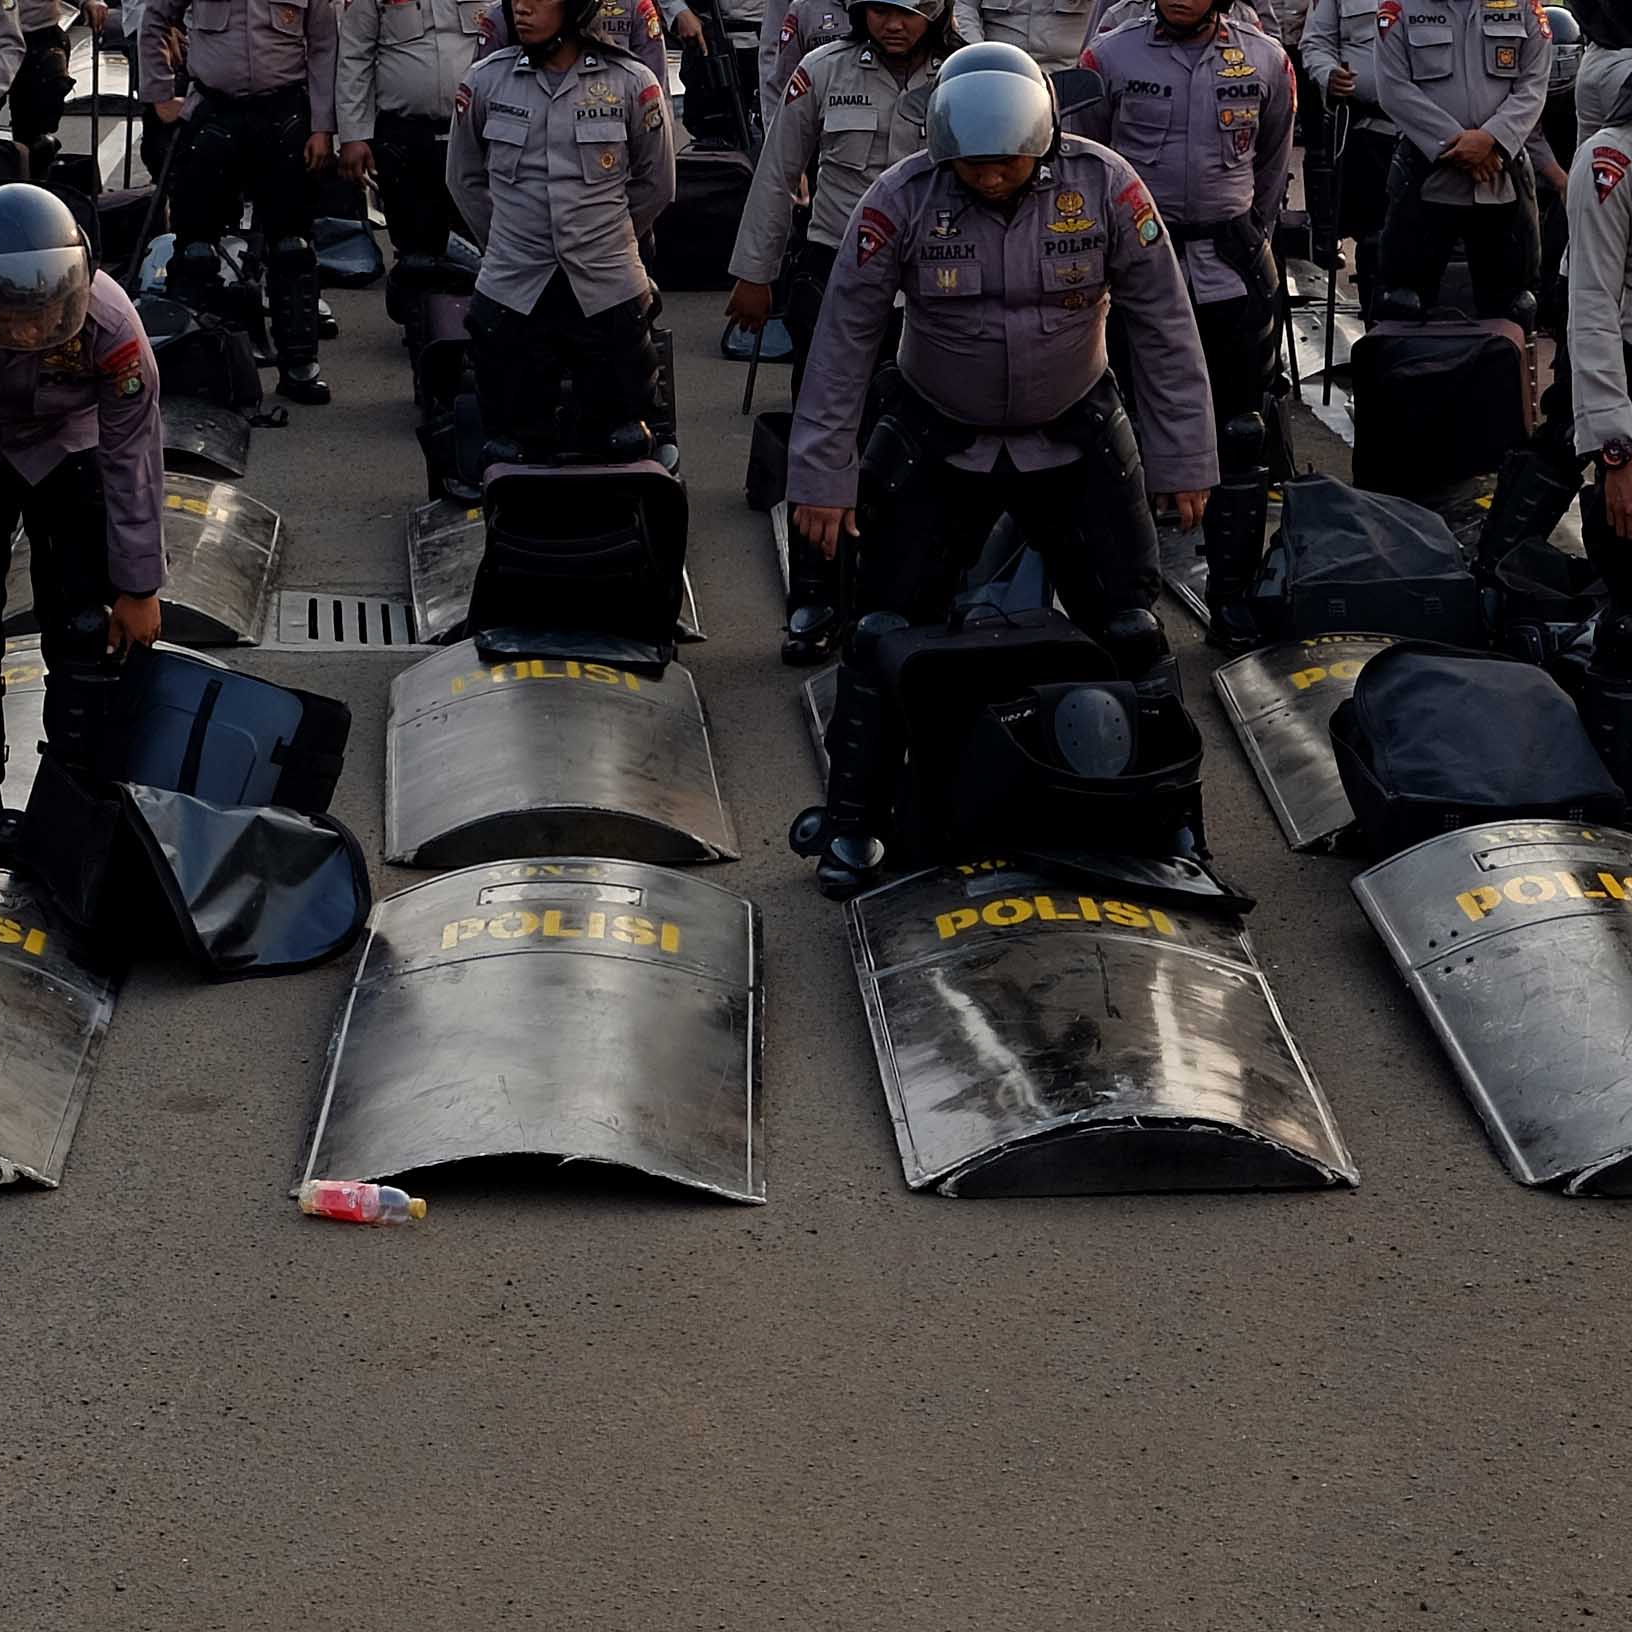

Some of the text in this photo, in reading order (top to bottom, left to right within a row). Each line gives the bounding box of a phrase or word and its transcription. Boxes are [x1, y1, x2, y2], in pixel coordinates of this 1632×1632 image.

[1408, 15, 1447, 24] BOWO
[1483, 12, 1522, 23] POLRI
[1125, 80, 1160, 97] JOKO
[1215, 82, 1260, 101] POLRI
[576, 107, 624, 121] POLRI
[936, 894, 1179, 939] POLISI
[441, 908, 681, 953] POLISI
